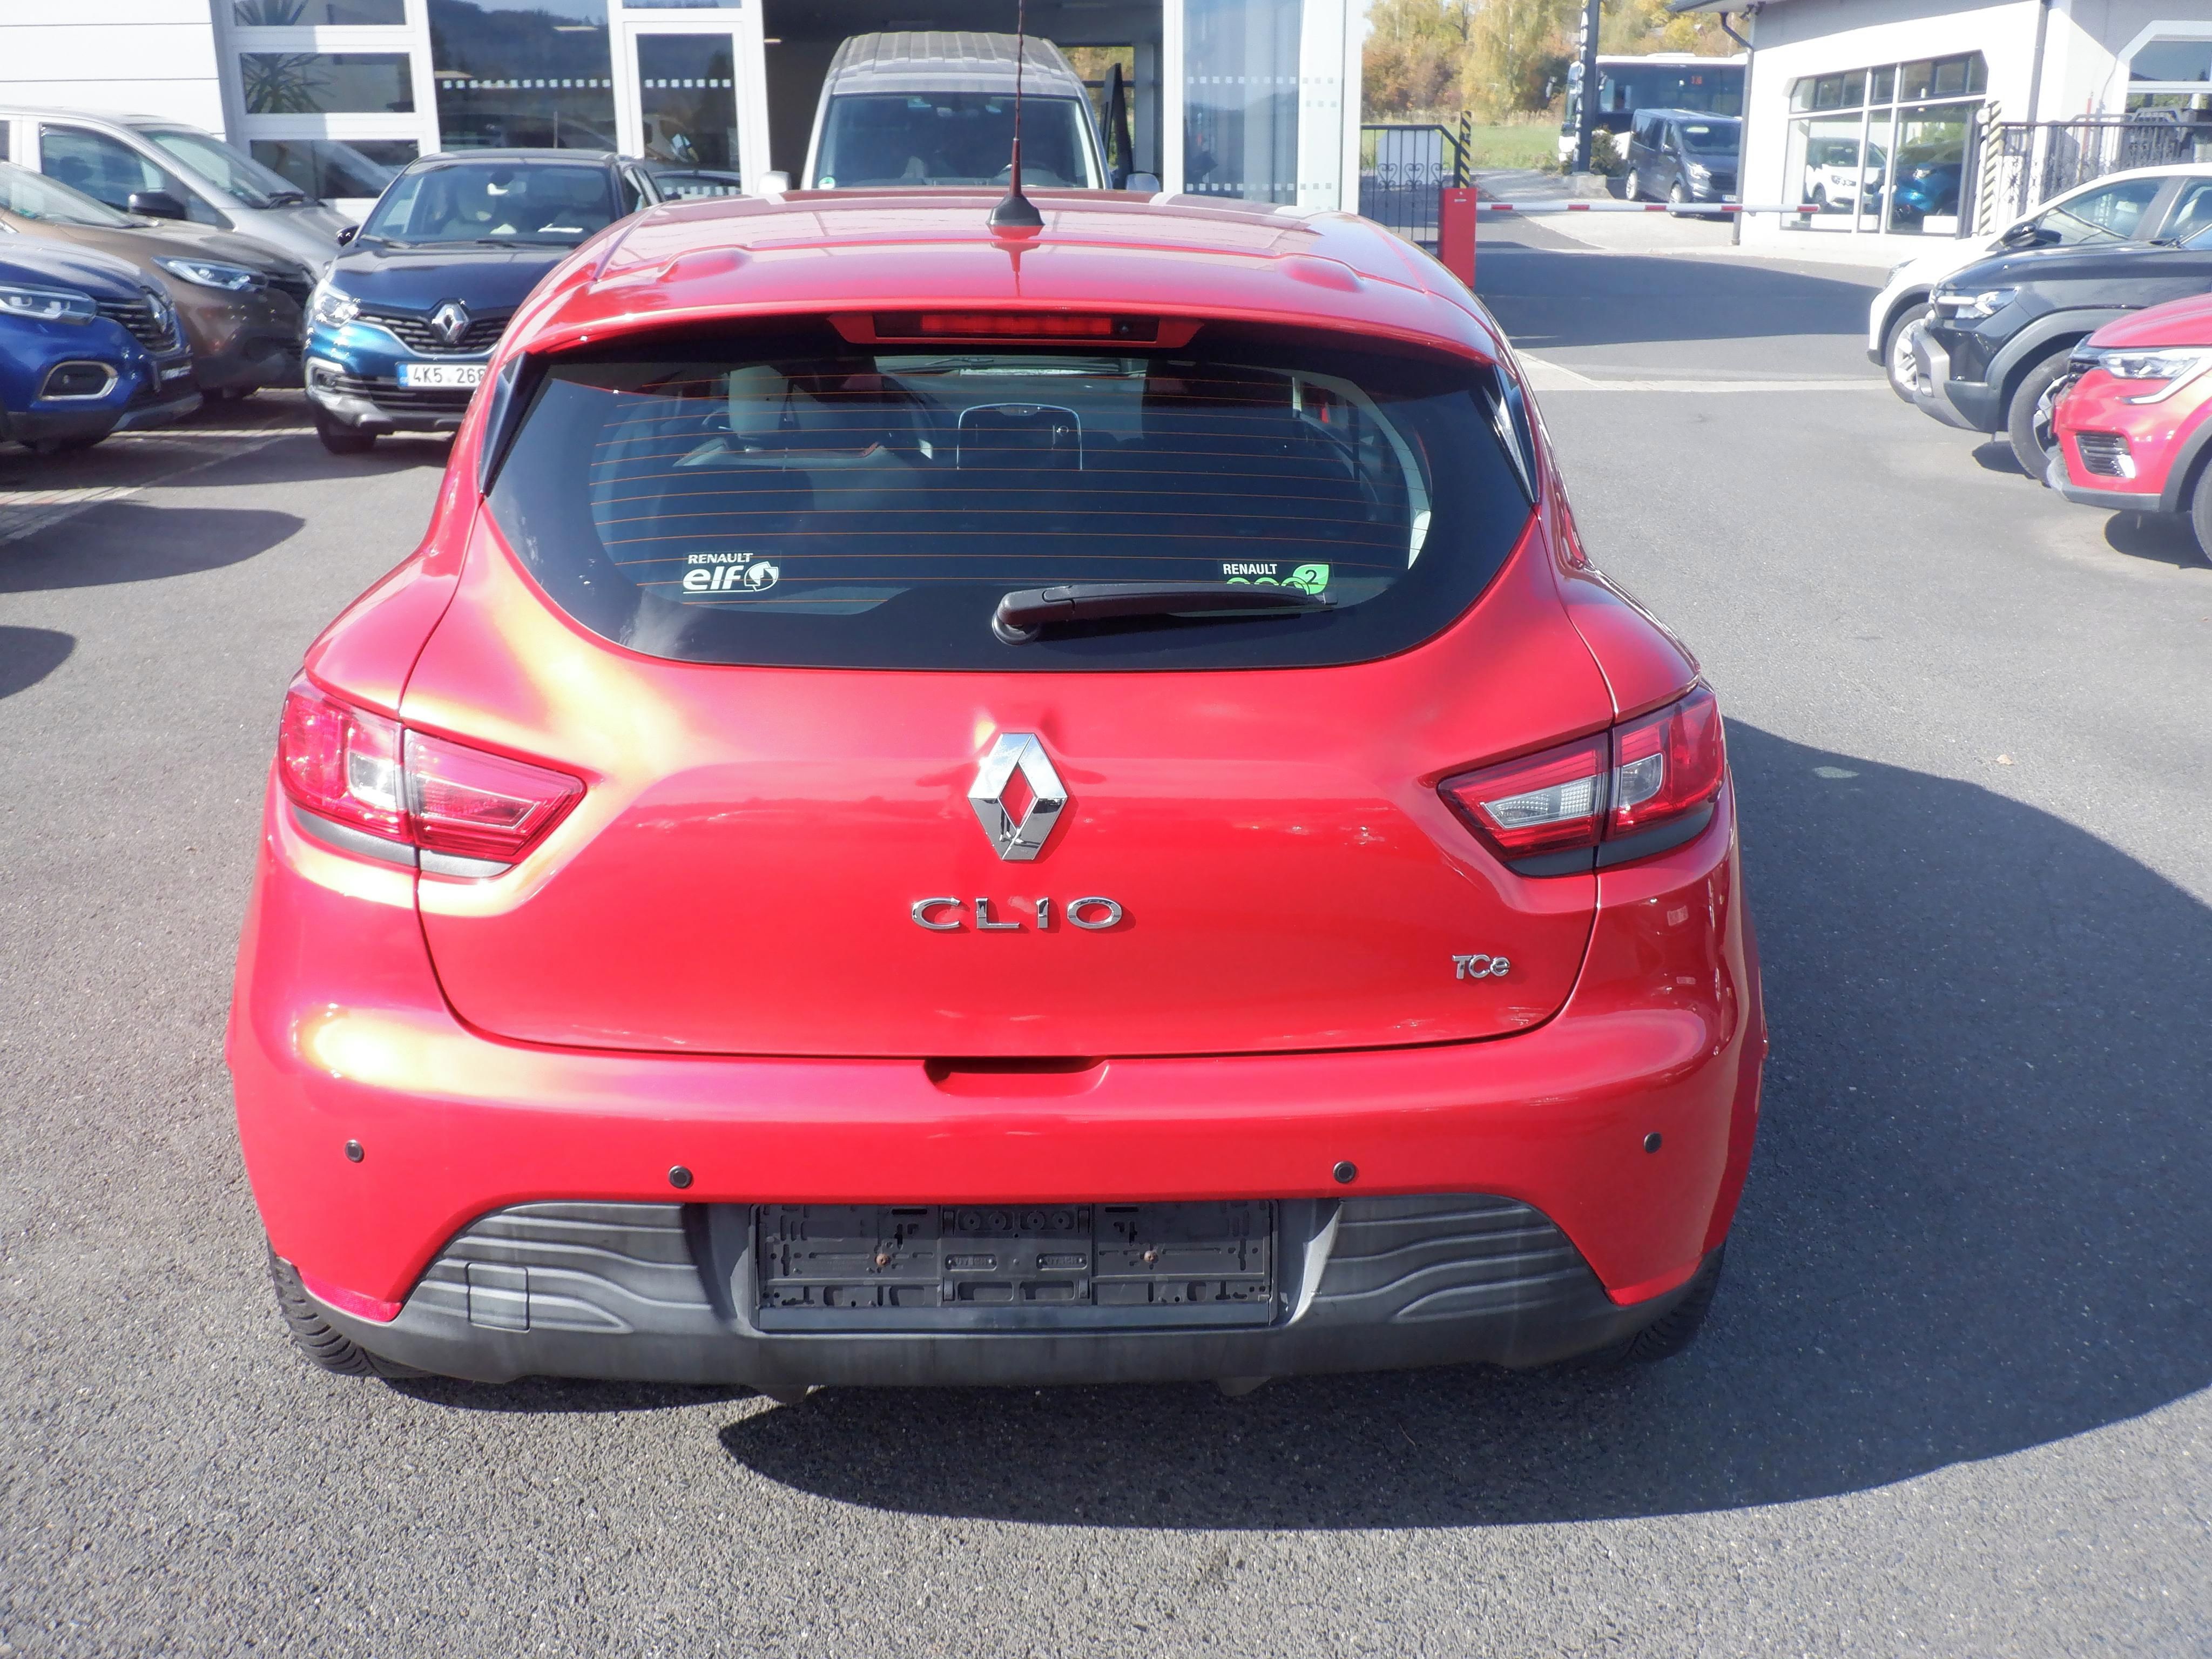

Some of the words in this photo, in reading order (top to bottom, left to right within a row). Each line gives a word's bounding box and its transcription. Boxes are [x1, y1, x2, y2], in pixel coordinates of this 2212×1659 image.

[414, 367, 443, 383] 4K5
[687, 552, 754, 564] RENAULT
[683, 565, 744, 590] elf
[1223, 563, 1278, 575] RENAULT
[911, 896, 1123, 929] CLIO
[1452, 954, 1510, 980] TCe
